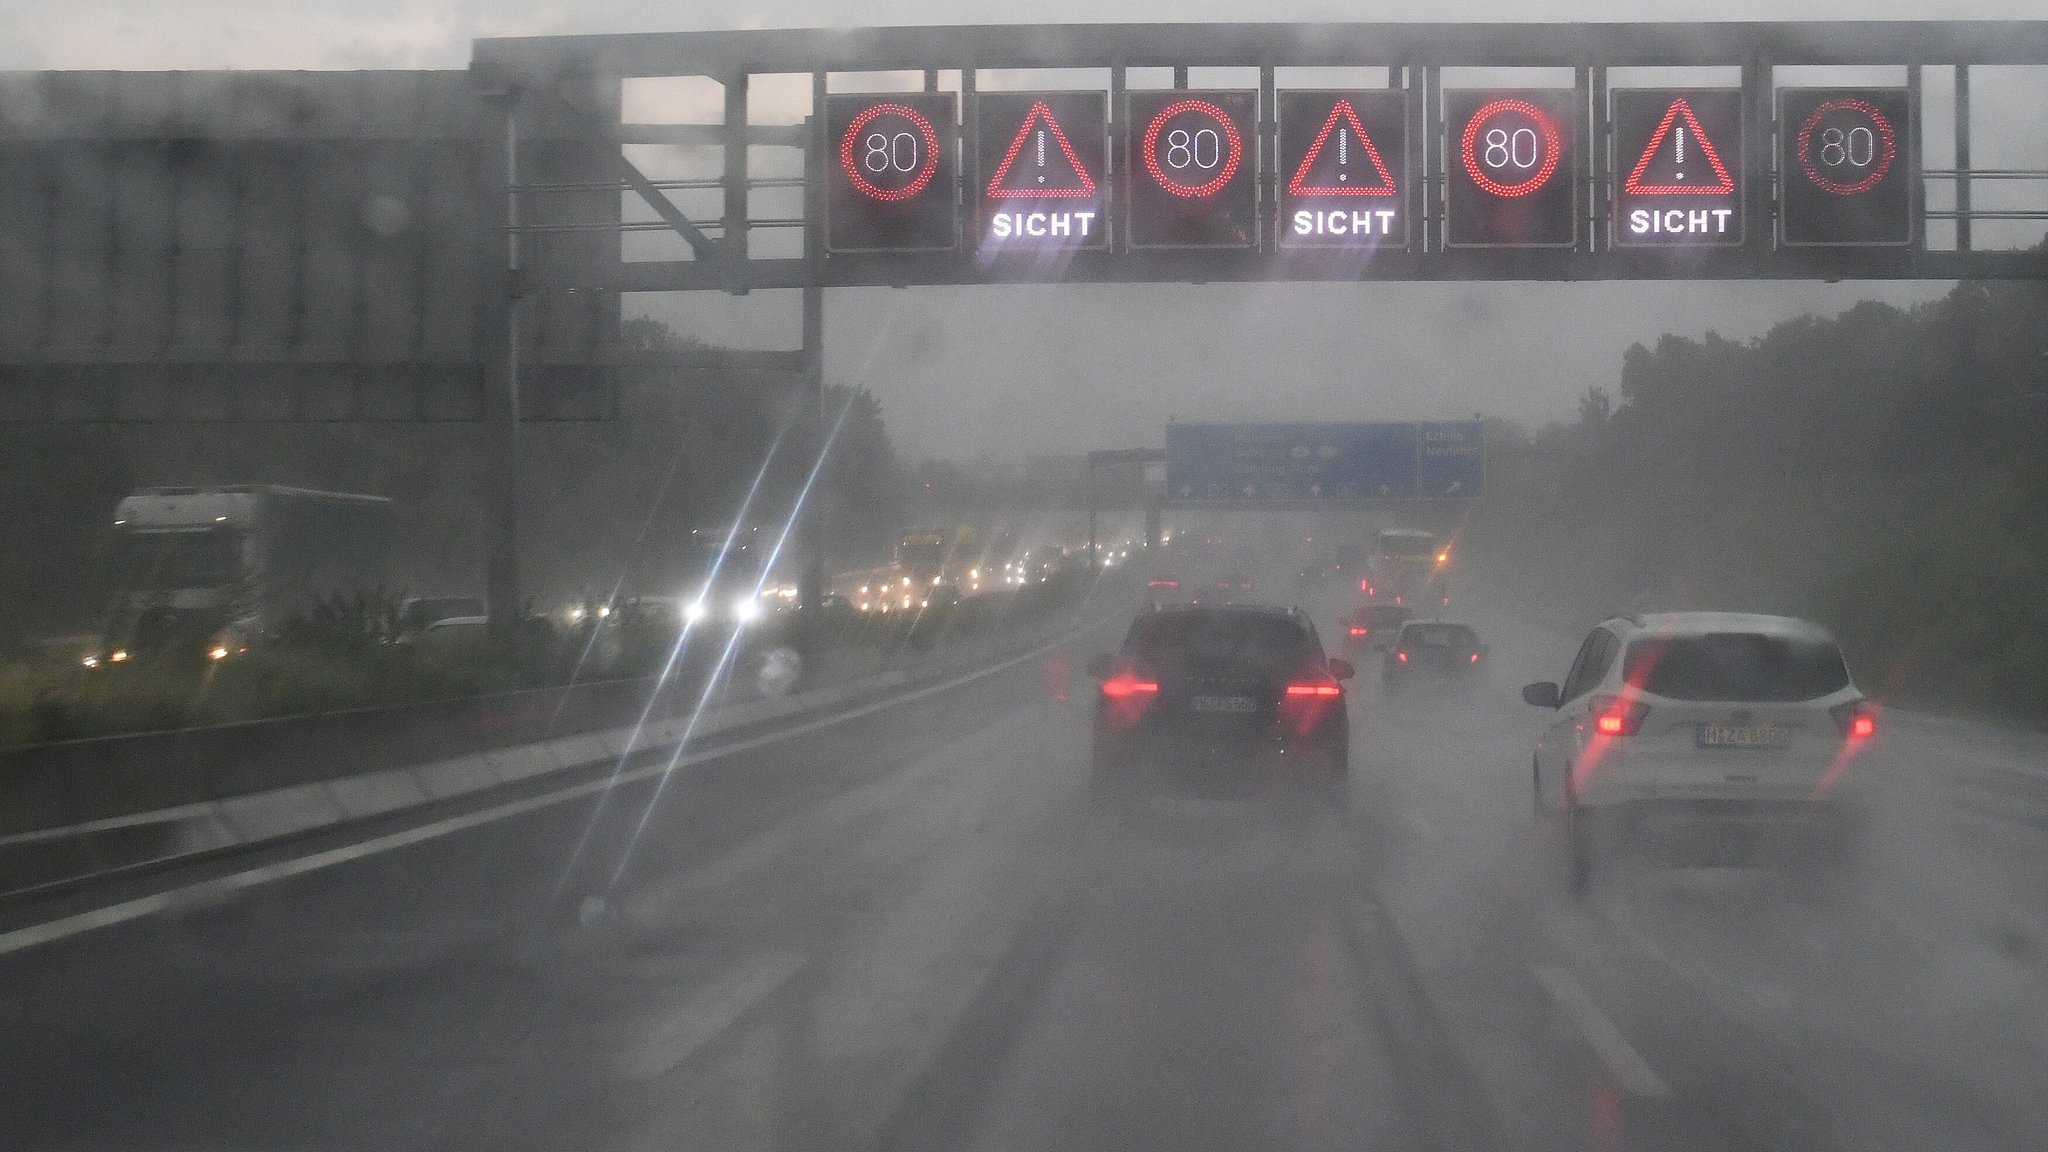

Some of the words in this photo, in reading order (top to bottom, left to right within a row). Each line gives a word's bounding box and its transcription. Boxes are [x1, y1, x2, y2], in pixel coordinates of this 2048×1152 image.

[865, 132, 917, 172] 80
[1167, 129, 1219, 169] 80
[1485, 128, 1537, 168] 80
[1822, 127, 1874, 167] 80
[992, 212, 1095, 238] SICHT
[1294, 210, 1395, 235] SICHT
[1630, 209, 1732, 234] SICHT
